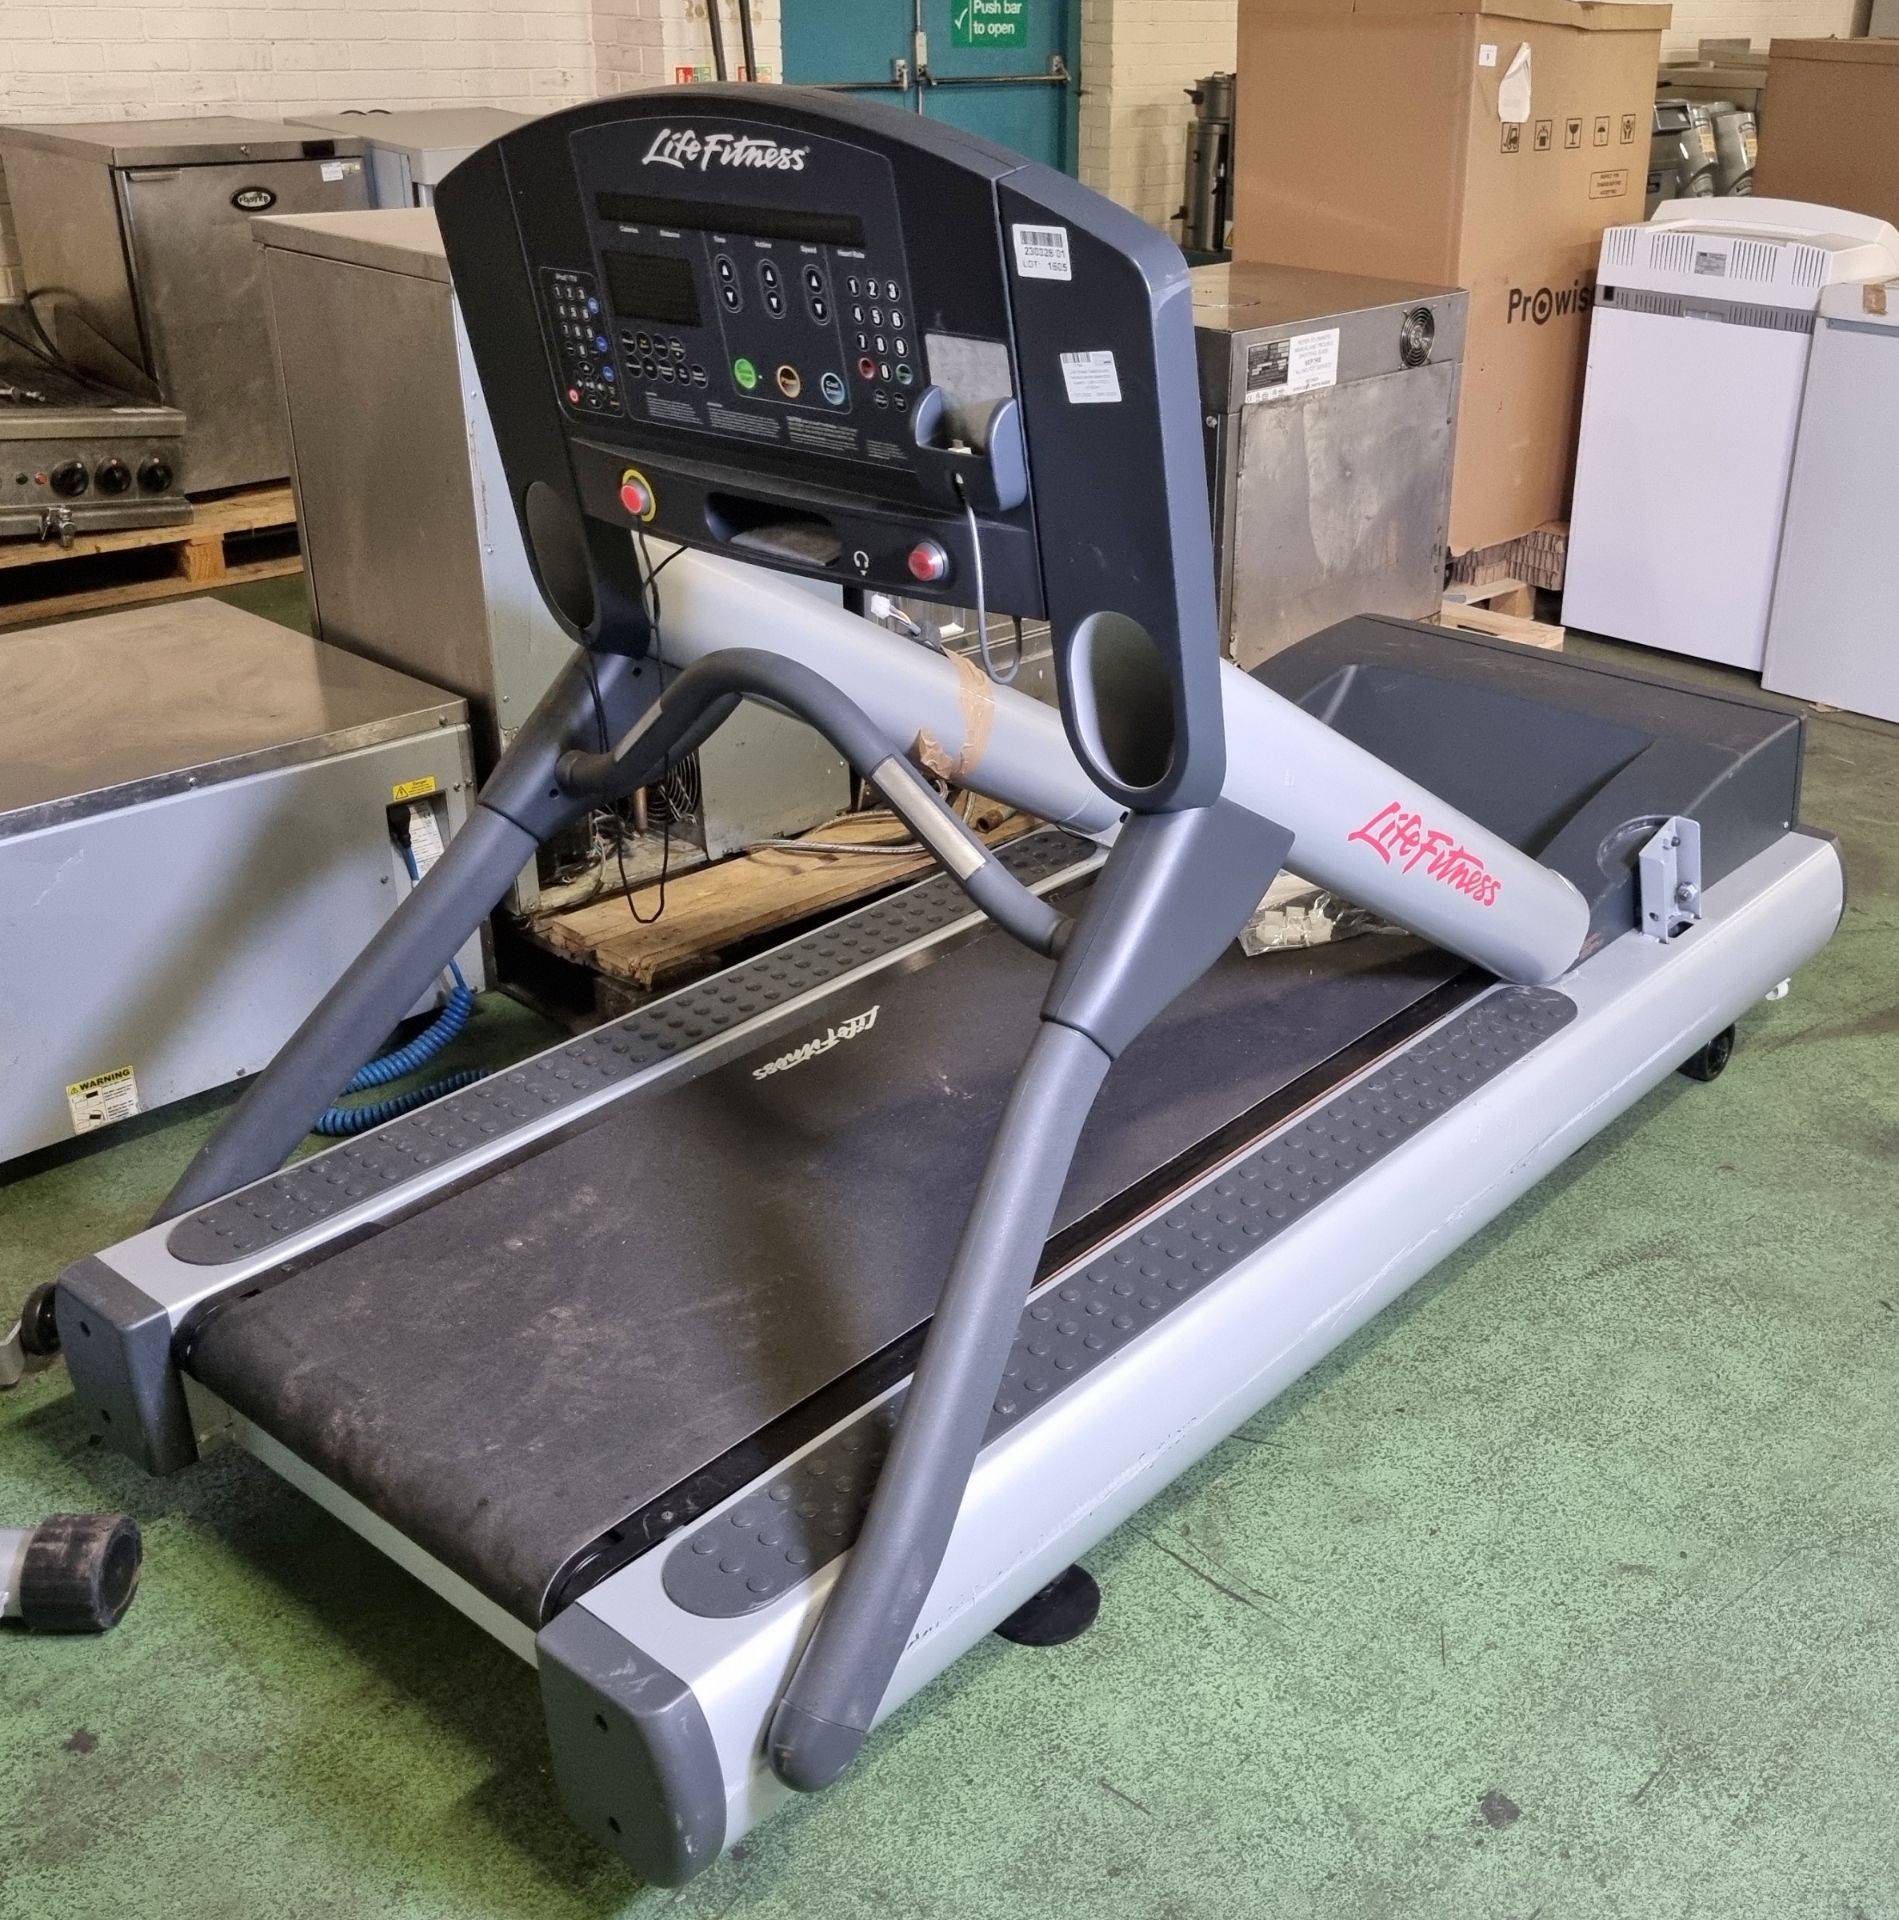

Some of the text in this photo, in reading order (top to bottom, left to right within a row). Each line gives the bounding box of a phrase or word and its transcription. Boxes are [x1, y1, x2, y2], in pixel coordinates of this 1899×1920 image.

[973, 0, 1022, 14] Push bar
[973, 21, 1016, 38] to open
[641, 128, 806, 172] Life Fitness
[849, 279, 896, 298] 1 2 3
[1507, 279, 1595, 325] PrOwis
[854, 307, 901, 327] 4 5 6
[858, 334, 904, 354] 7 8 9
[1347, 801, 1501, 906] Life Fitness
[752, 1005, 880, 1080] Life Fitness
[79, 1068, 131, 1091] WARNING
